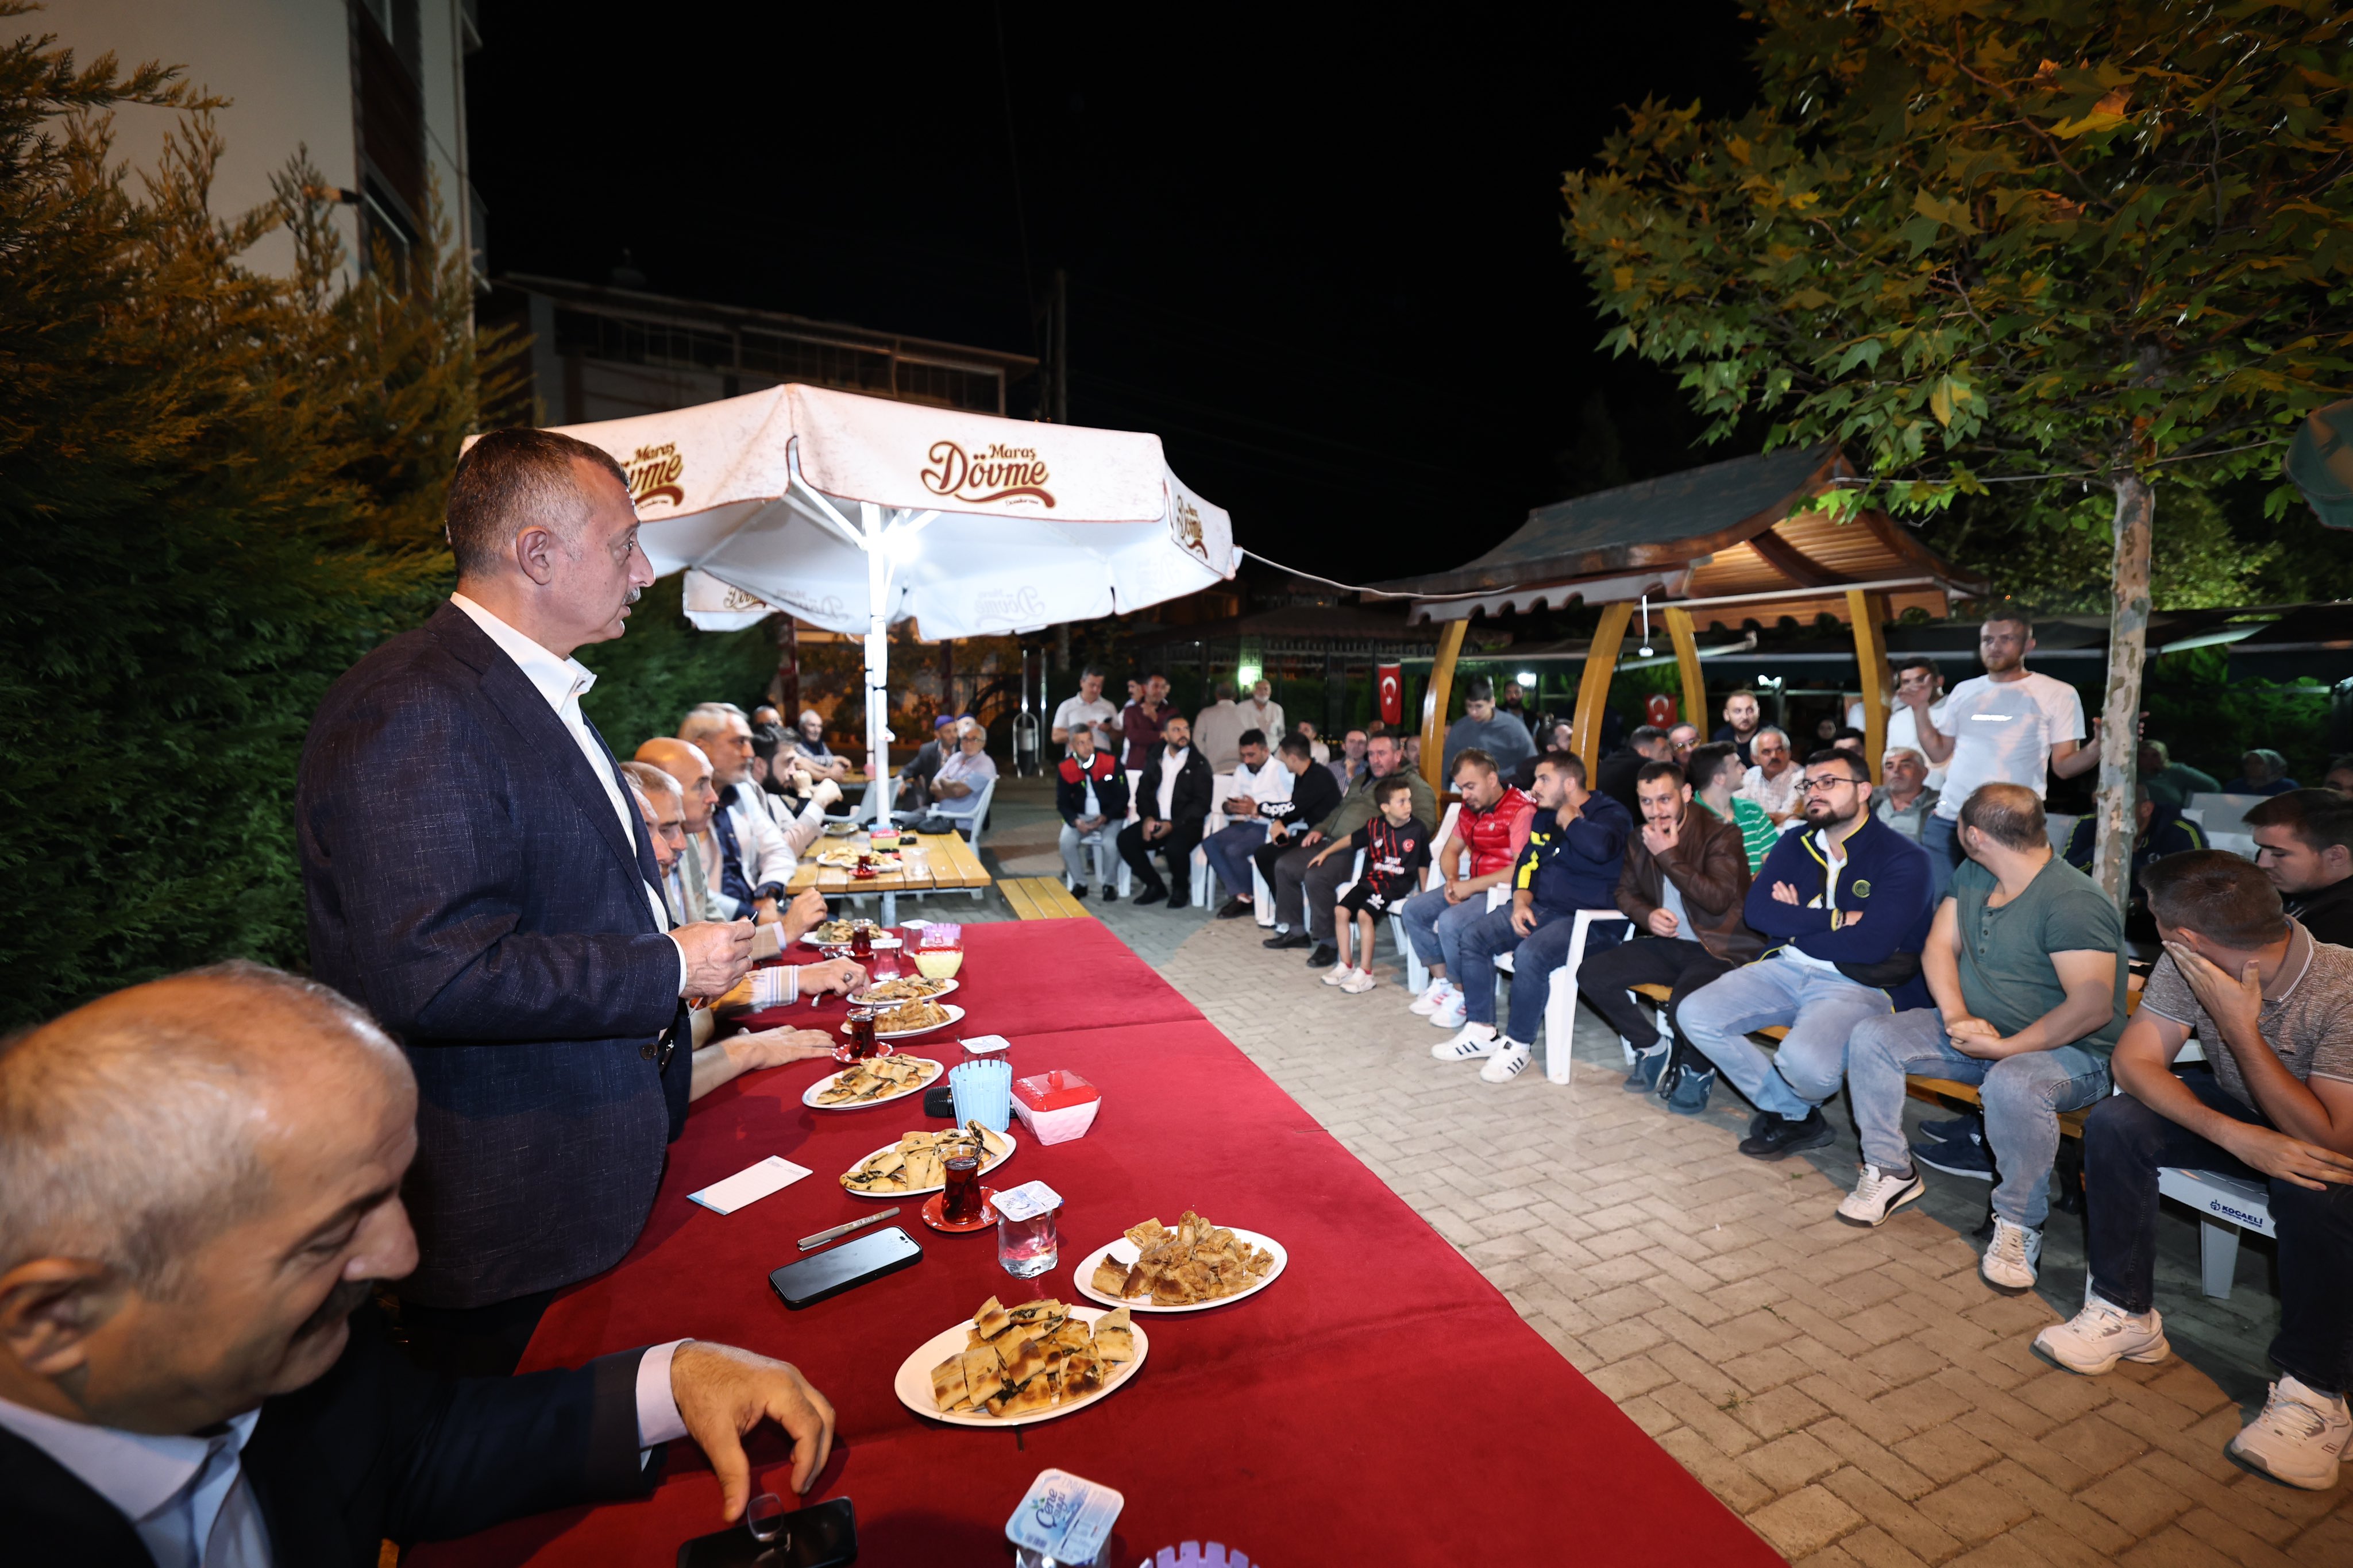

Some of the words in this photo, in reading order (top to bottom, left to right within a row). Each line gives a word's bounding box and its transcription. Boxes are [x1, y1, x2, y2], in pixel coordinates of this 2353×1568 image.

[920, 440, 1050, 496] Dövme
[989, 443, 1036, 461] Maraş
[622, 453, 684, 494] vme
[1036, 1488, 1058, 1529] Çene
